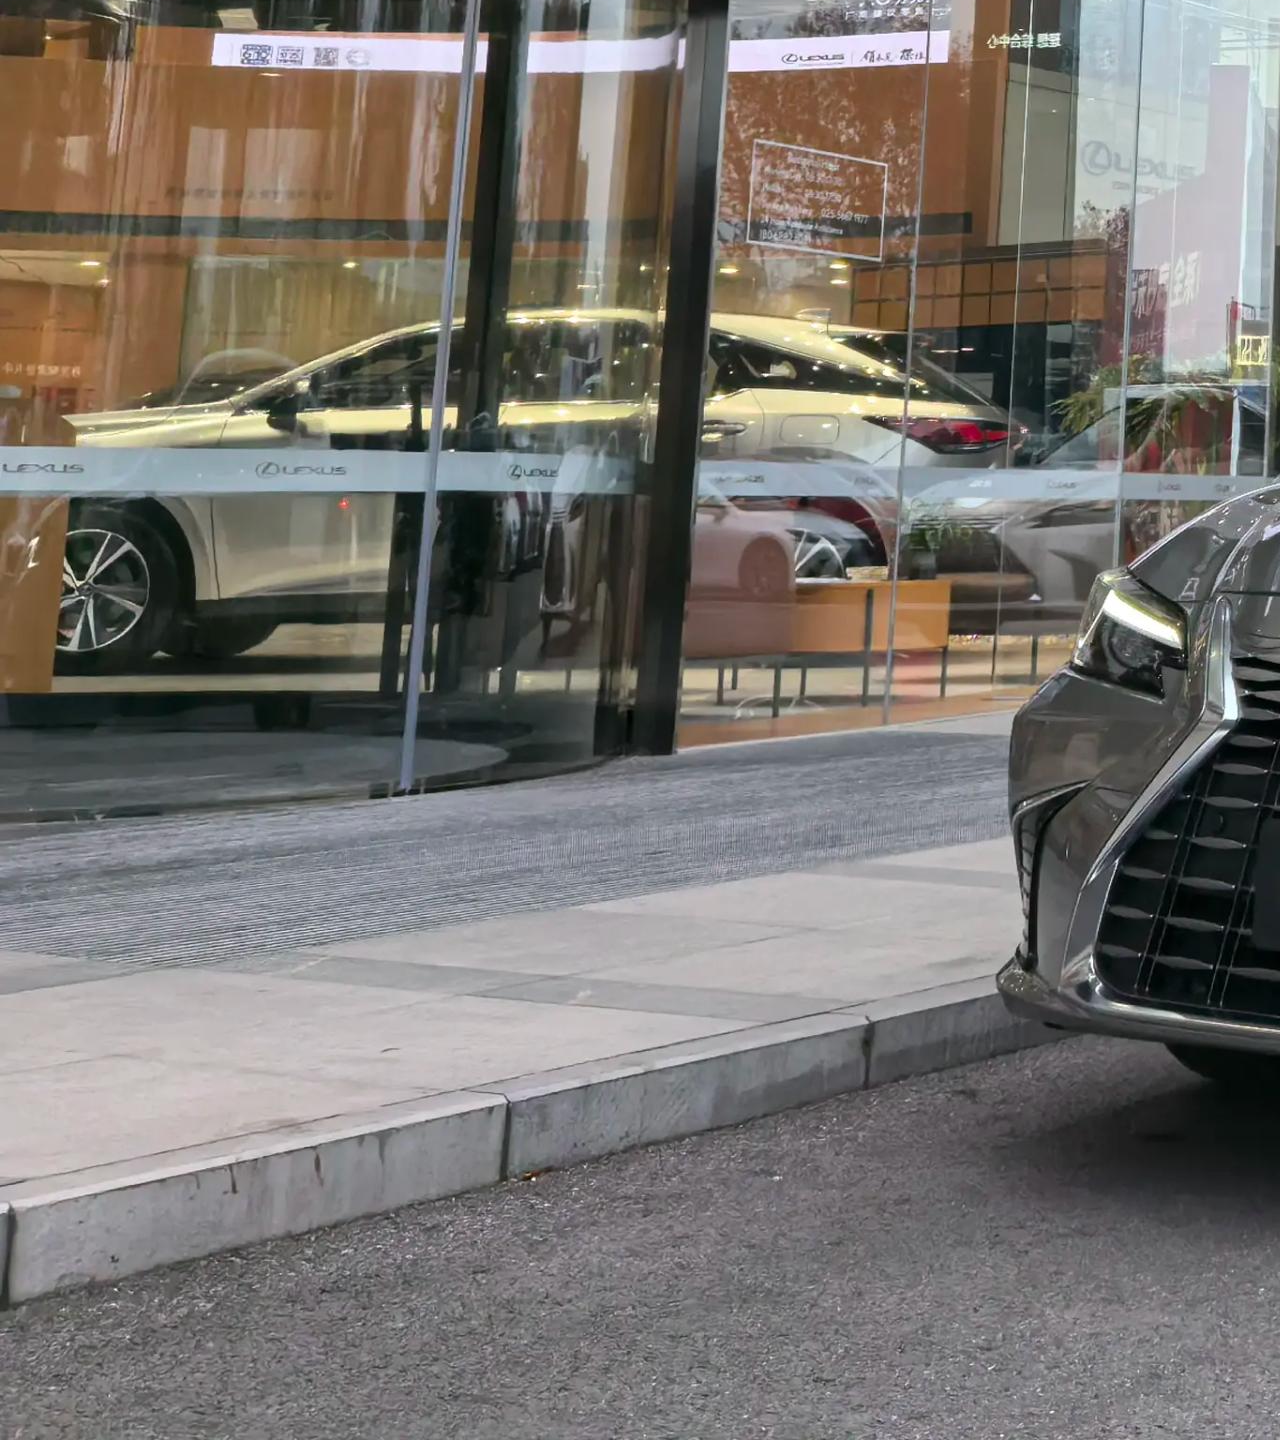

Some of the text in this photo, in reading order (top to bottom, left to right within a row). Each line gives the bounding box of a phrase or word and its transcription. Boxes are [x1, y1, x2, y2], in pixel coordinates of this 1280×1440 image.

[799, 53, 846, 62] LEXUS
[2, 463, 85, 474] LEXUS
[283, 466, 347, 476] LEXUS
